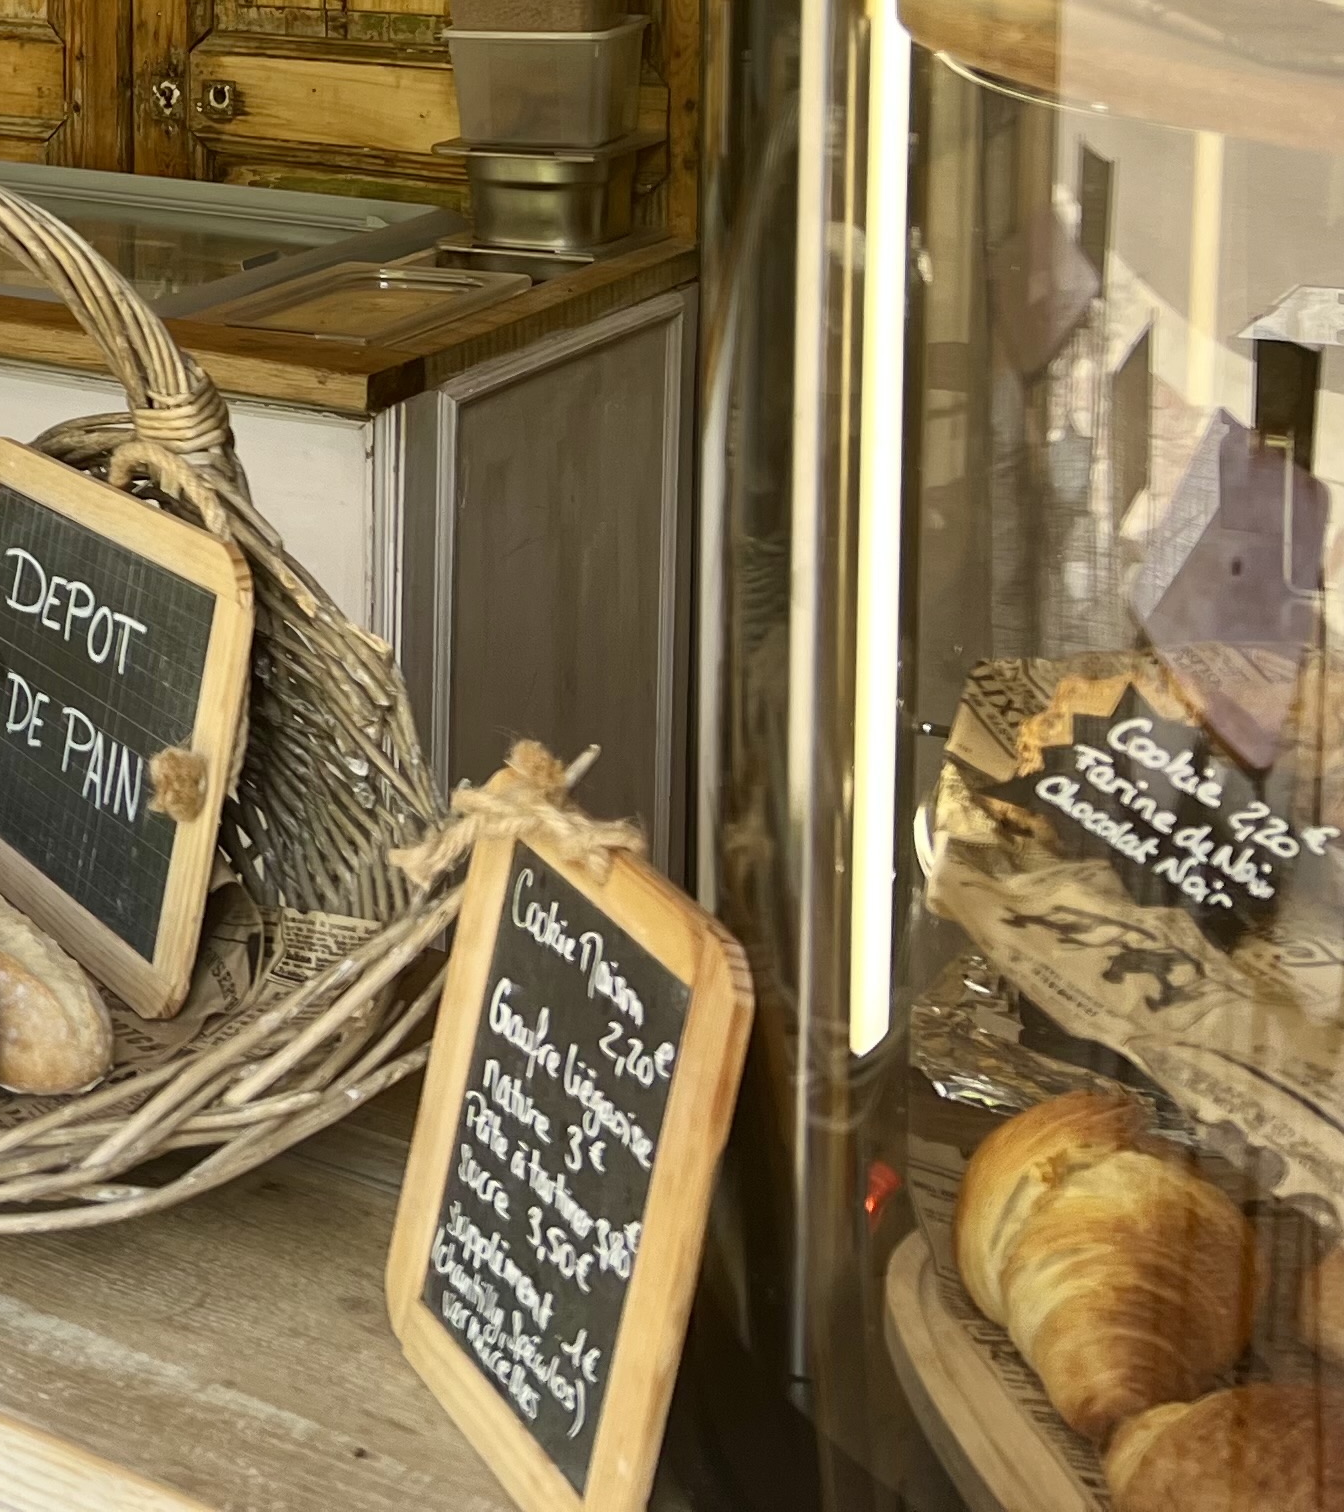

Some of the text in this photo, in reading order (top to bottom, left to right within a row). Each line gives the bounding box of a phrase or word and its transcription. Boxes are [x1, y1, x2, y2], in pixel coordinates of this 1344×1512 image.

[4, 546, 148, 675] DEPOT
[5, 671, 144, 824] DE PAIN
[1072, 743, 1178, 835] Farine
[1172, 824, 1214, 866] de
[1106, 716, 1222, 808] Cookie
[1035, 774, 1234, 909] Chocolat Noir
[512, 867, 577, 962] Cookie
[488, 976, 562, 1080] Gaufre
